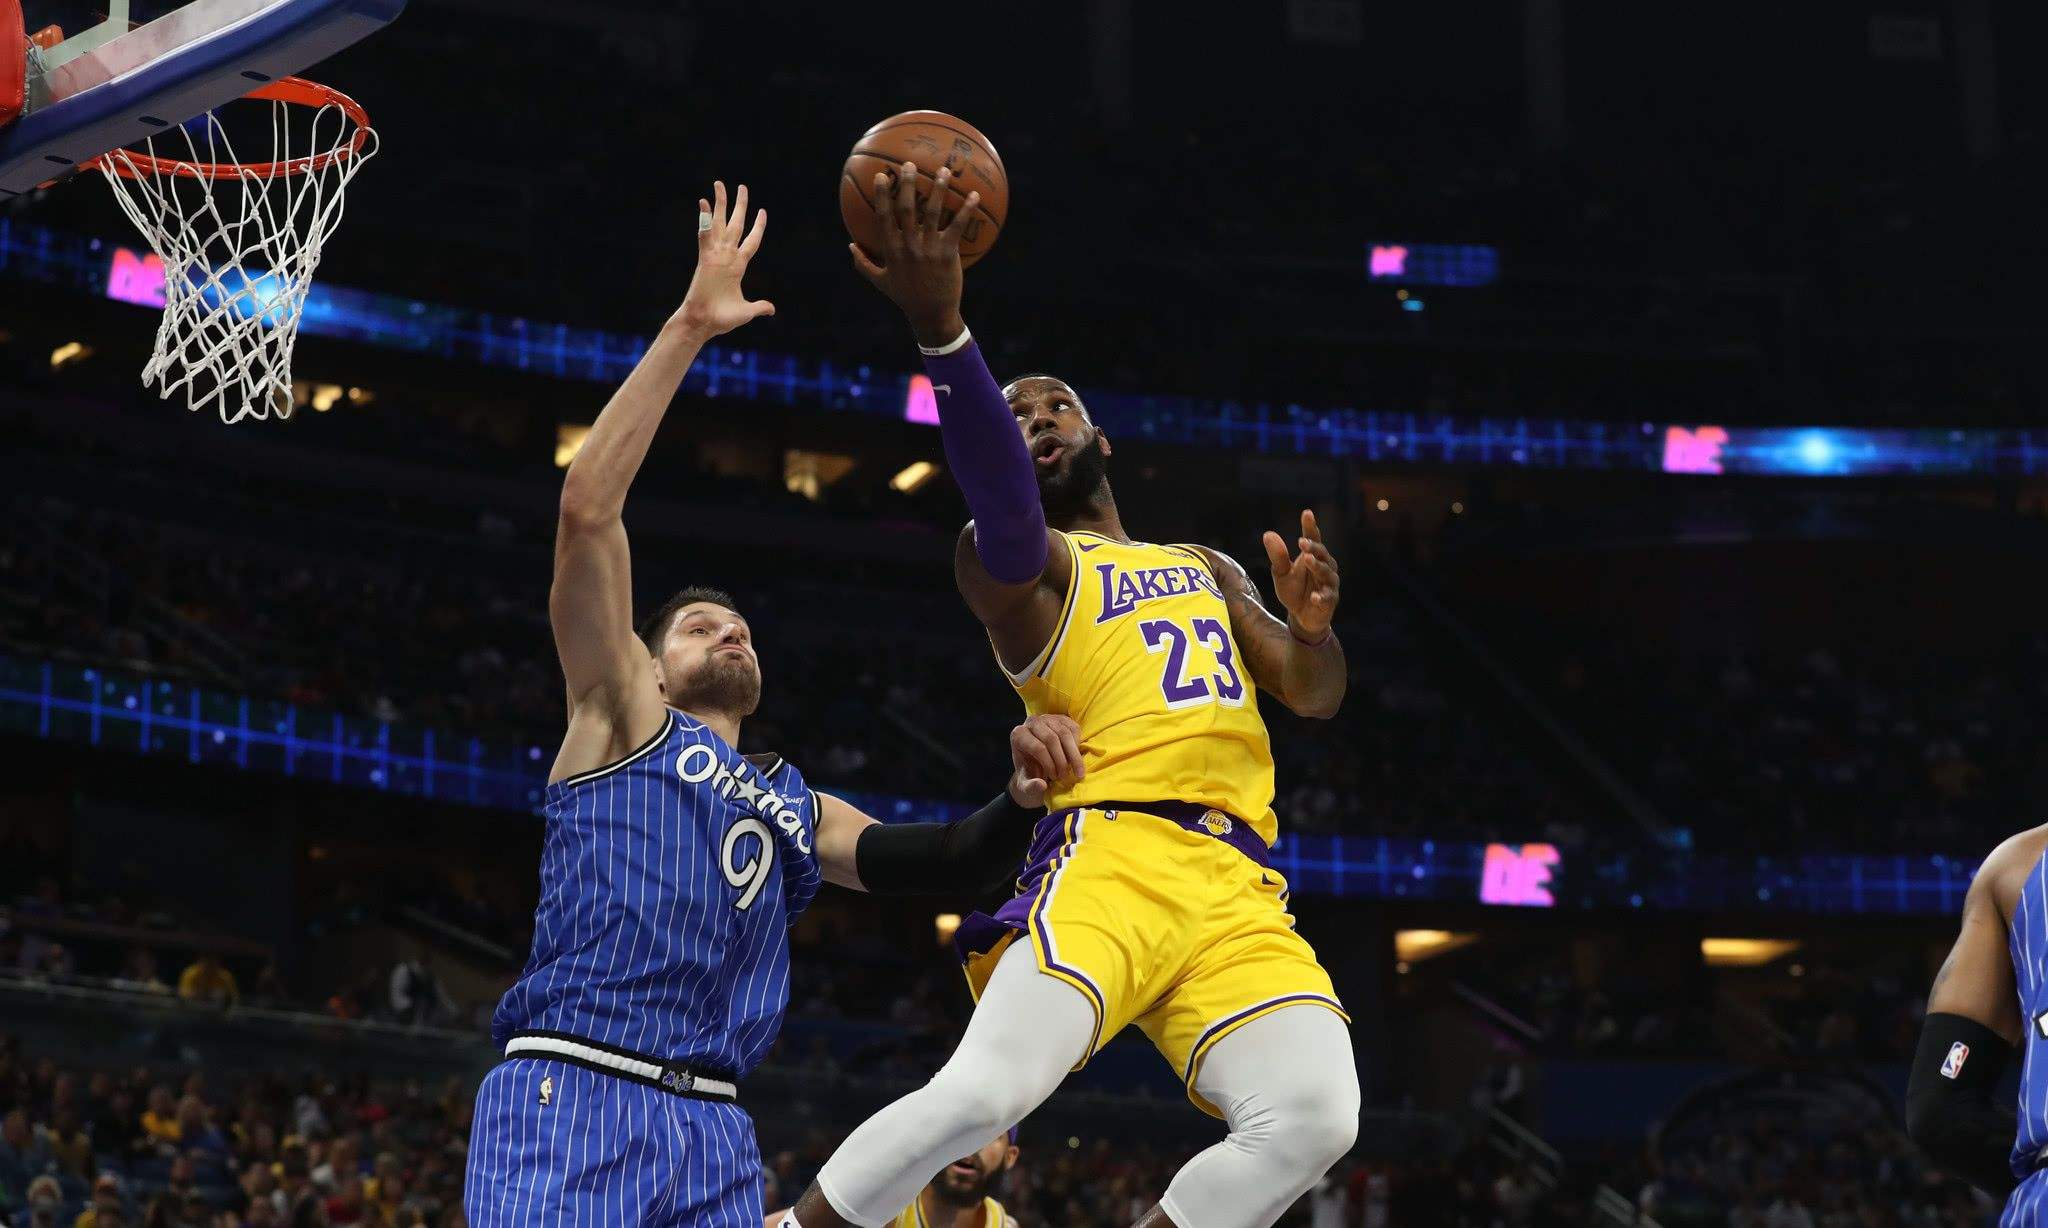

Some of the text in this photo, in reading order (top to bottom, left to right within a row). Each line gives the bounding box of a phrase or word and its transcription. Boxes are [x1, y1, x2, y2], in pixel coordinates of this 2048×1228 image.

[1094, 562, 1226, 626] LAKERS
[1138, 617, 1243, 710] 23
[721, 818, 775, 910] 9
